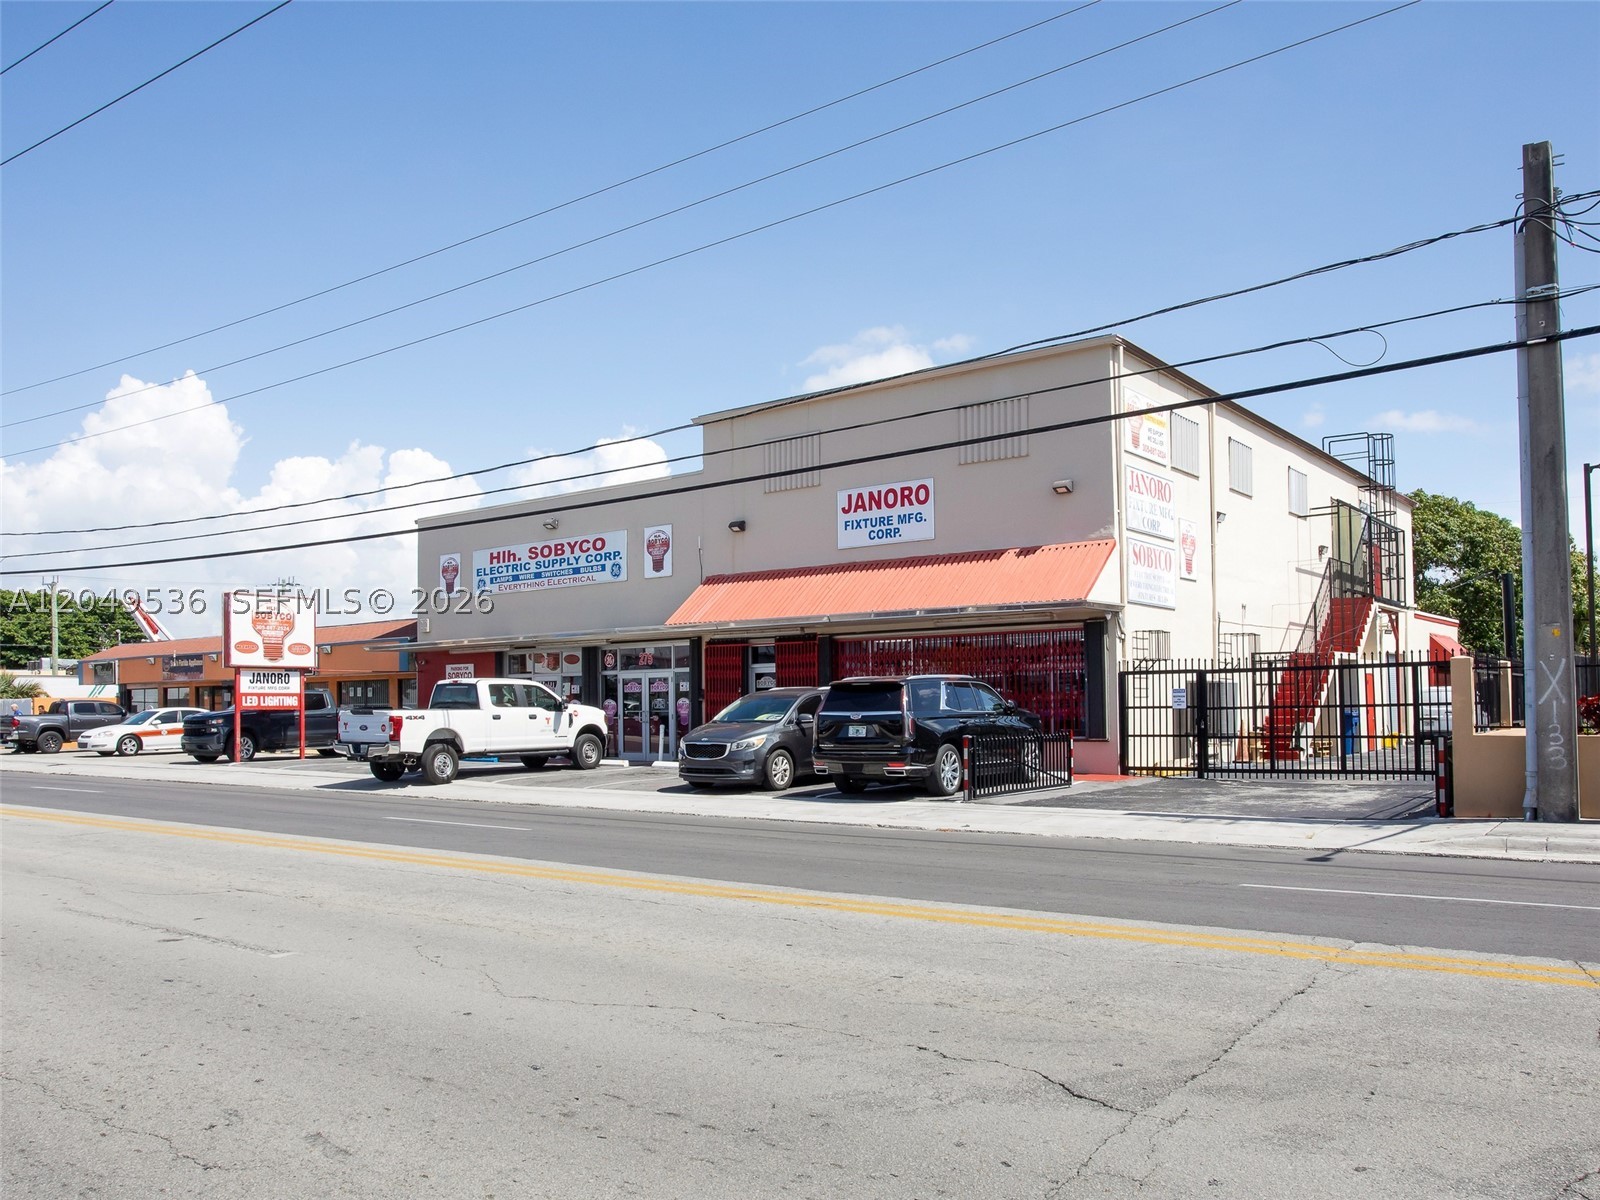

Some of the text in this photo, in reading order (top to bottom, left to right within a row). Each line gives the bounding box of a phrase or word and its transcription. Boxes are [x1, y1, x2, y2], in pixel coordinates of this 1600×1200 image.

[1129, 470, 1172, 503] JANORO
[841, 484, 930, 514] JANORO
[844, 512, 927, 531] FIXTURE MFG.
[1142, 516, 1162, 533] CORP.
[868, 527, 902, 540] CORP.
[528, 537, 606, 560] SOBYCO
[1132, 543, 1172, 573] SOBYCO
[476, 550, 623, 577] ELECTRIC SUPPLY CORP.
[493, 575, 513, 583] LAMPS
[541, 568, 574, 578] SWITCHES
[580, 565, 602, 573] BULBS
[249, 672, 290, 684] JANORO
[242, 696, 298, 706] LED LIGHTING
